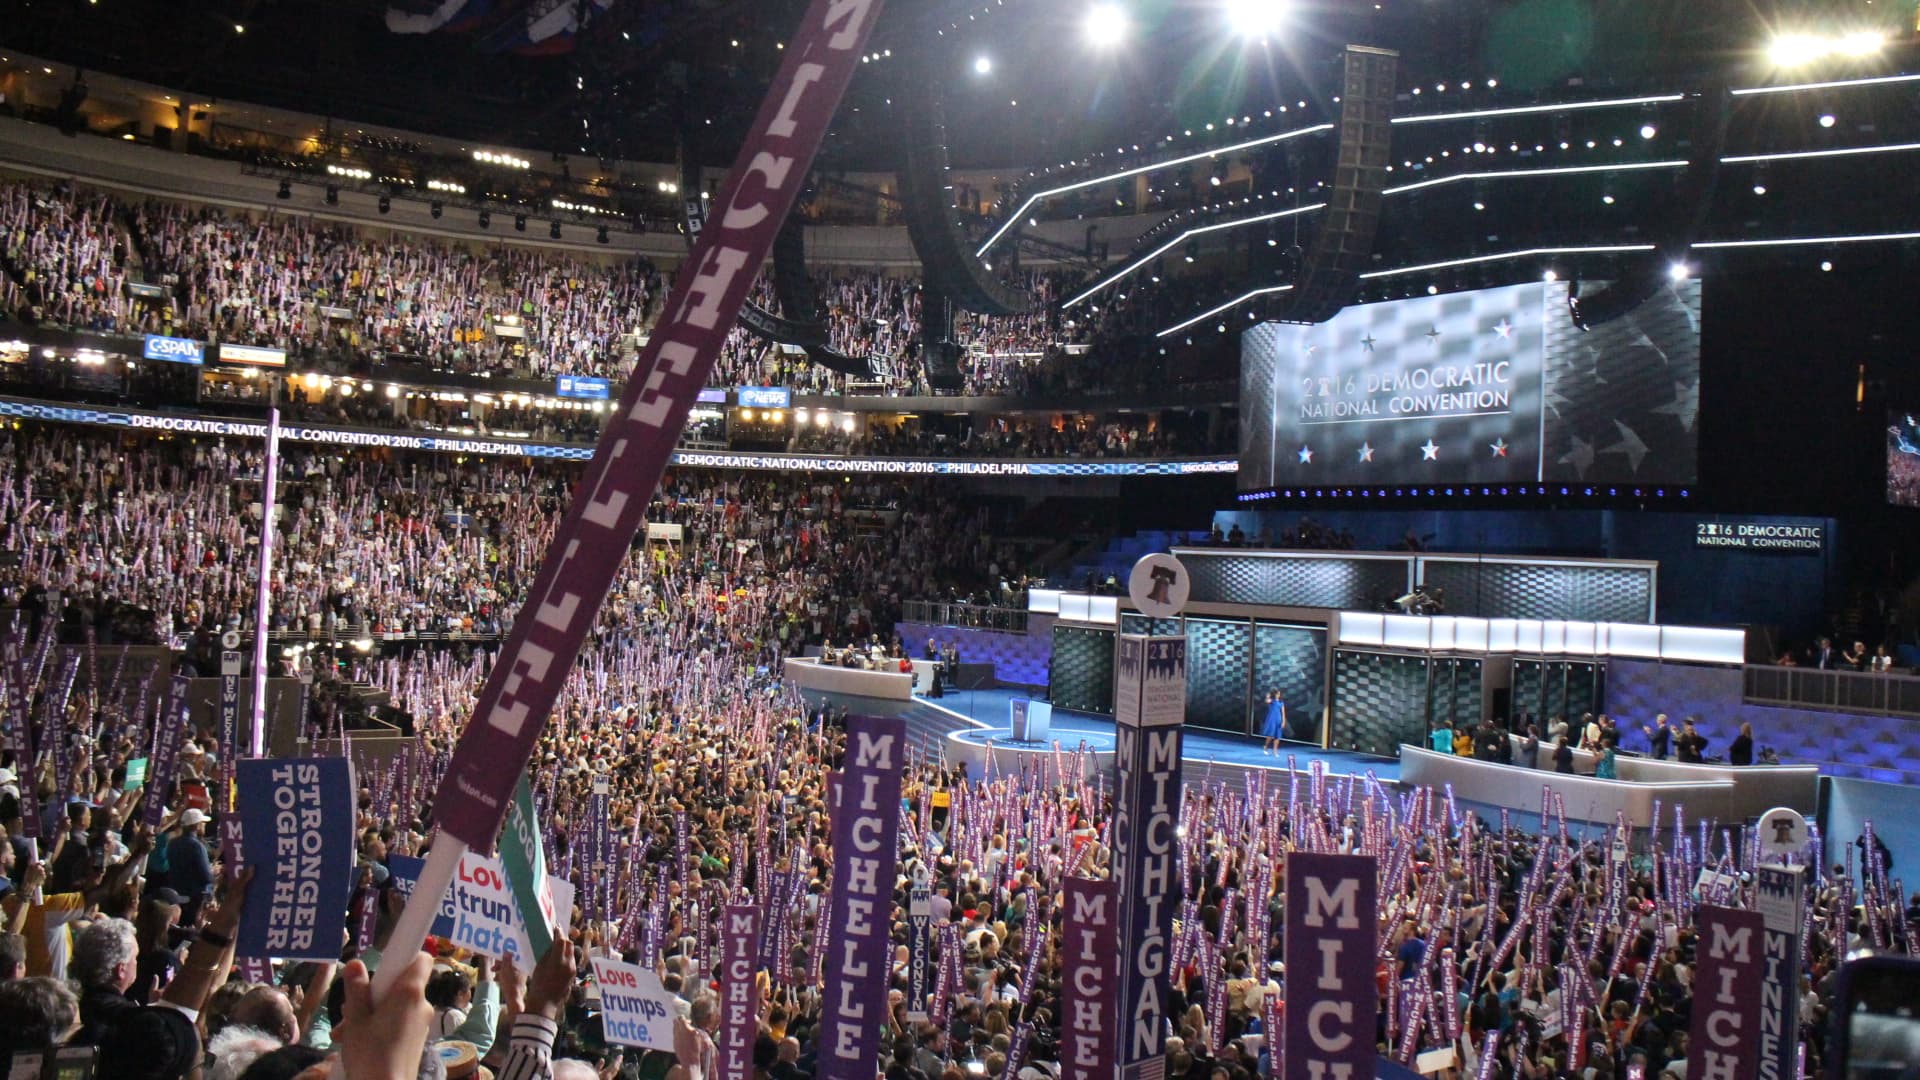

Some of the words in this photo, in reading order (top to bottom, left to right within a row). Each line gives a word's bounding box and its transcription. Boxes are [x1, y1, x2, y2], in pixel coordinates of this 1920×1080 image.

[149, 339, 199, 356] C-SPAN
[488, 0, 874, 737] MICHELLE
[1367, 361, 1509, 393] DEMOCRATIC
[131, 415, 224, 435] DEMOCRATIC
[301, 429, 391, 447] CONVENTION
[392, 436, 421, 449] 2016
[1301, 401, 1379, 418] NATIONAL
[1389, 390, 1509, 414] CONVENTION
[434, 439, 523, 455] PHILADELPHIA
[679, 453, 760, 468] DEMOCRATIC
[763, 457, 824, 471] NATIONAL
[826, 460, 906, 472] CONVENTION
[908, 462, 934, 473] 2016
[947, 462, 1029, 474] PHILADELPHIA
[1697, 537, 1747, 546] NATIONAL
[1752, 538, 1820, 548] CONVENTION
[1738, 525, 1820, 538] DEMOCRATIC
[224, 676, 236, 702] NEW
[5, 642, 33, 816] MICHELLE
[150, 681, 187, 809] MICHELLE
[223, 707, 235, 745] MEXI
[266, 764, 298, 949] TOGETHER
[291, 764, 323, 950] STRONGER
[580, 834, 591, 911] MICHELLE
[657, 865, 669, 939] MICHELLE
[681, 853, 689, 928] MICHELLE
[764, 875, 785, 958] MICHELLE
[835, 732, 894, 1060] MICHELLE
[1133, 730, 1177, 1060] MICHIGAN
[1221, 890, 1236, 944] MICHELLE
[1257, 865, 1270, 920] MICHELLE
[1612, 861, 1622, 925] FLORIDA
[1865, 892, 1882, 947] MICHELLE
[457, 914, 521, 961] hate.
[699, 891, 708, 970] MICHELLE
[812, 896, 825, 977] MICHELLE
[950, 925, 963, 987] MICHELLE
[1182, 902, 1198, 962] MICHELLE
[1261, 913, 1269, 978] MICHELLE
[1536, 908, 1544, 964] MICHELLE
[595, 962, 637, 988] Love
[912, 916, 928, 1012] WISCONSIN
[934, 949, 951, 1016] MICHELLE
[1024, 934, 1045, 1000] MICHELLE
[1443, 957, 1456, 1032] MICHELLE
[602, 989, 666, 1021] trumps
[605, 1013, 652, 1042] hate.
[1214, 983, 1226, 1050] MICHELLE
[1400, 993, 1425, 1062] MICHELLE
[1419, 966, 1440, 1039] MICHELLE
[1561, 966, 1569, 1027] MICHELLE
[1266, 996, 1278, 1069] MICHELLE
[1569, 1005, 1585, 1072] MICHELLE
